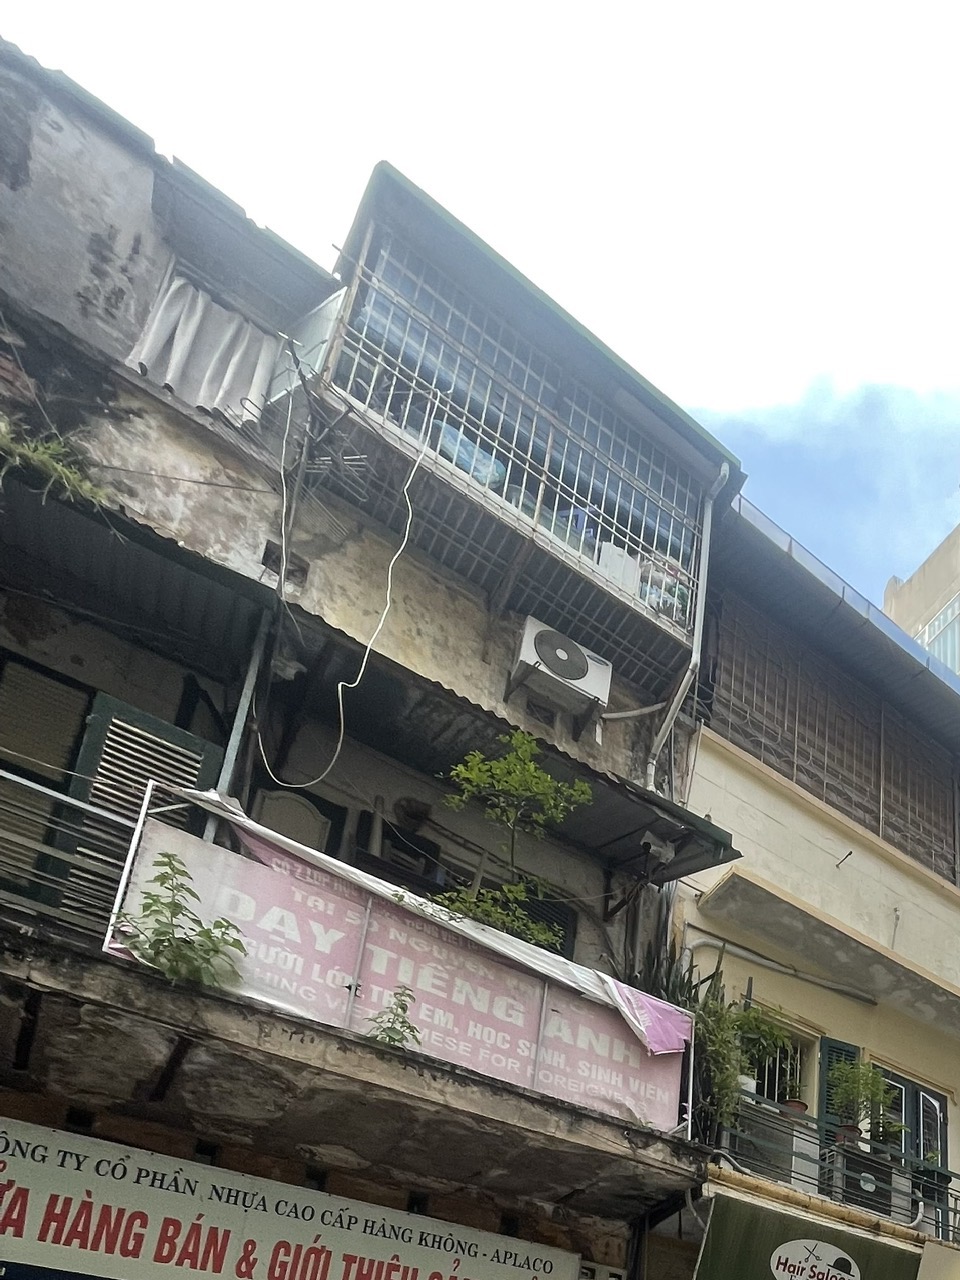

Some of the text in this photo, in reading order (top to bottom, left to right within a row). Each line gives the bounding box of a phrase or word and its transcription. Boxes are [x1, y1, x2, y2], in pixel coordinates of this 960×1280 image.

[219, 886, 345, 954] DẠY
[365, 942, 525, 1028] TIẾNG
[543, 1015, 641, 1070] ANH
[419, 1003, 459, 1034] EM,
[467, 1021, 511, 1049] HỌC
[577, 1060, 623, 1088] SINH
[479, 1047, 522, 1073] FOR
[37, 1189, 148, 1259] HÀNG
[153, 1214, 232, 1275] BÁN
[235, 1239, 258, 1280] &
[57, 1150, 89, 1172] TY
[95, 1155, 128, 1180] CỔ
[133, 1162, 200, 1197] PHẦN
[208, 1184, 269, 1213] NHỰA
[274, 1199, 315, 1223] CAO
[320, 1203, 359, 1231] CẤP
[363, 1216, 414, 1244] HÀNG
[418, 1226, 479, 1258] KHÔNG
[490, 1247, 555, 1275] APLACO
[775, 1256, 807, 1278] Hair
